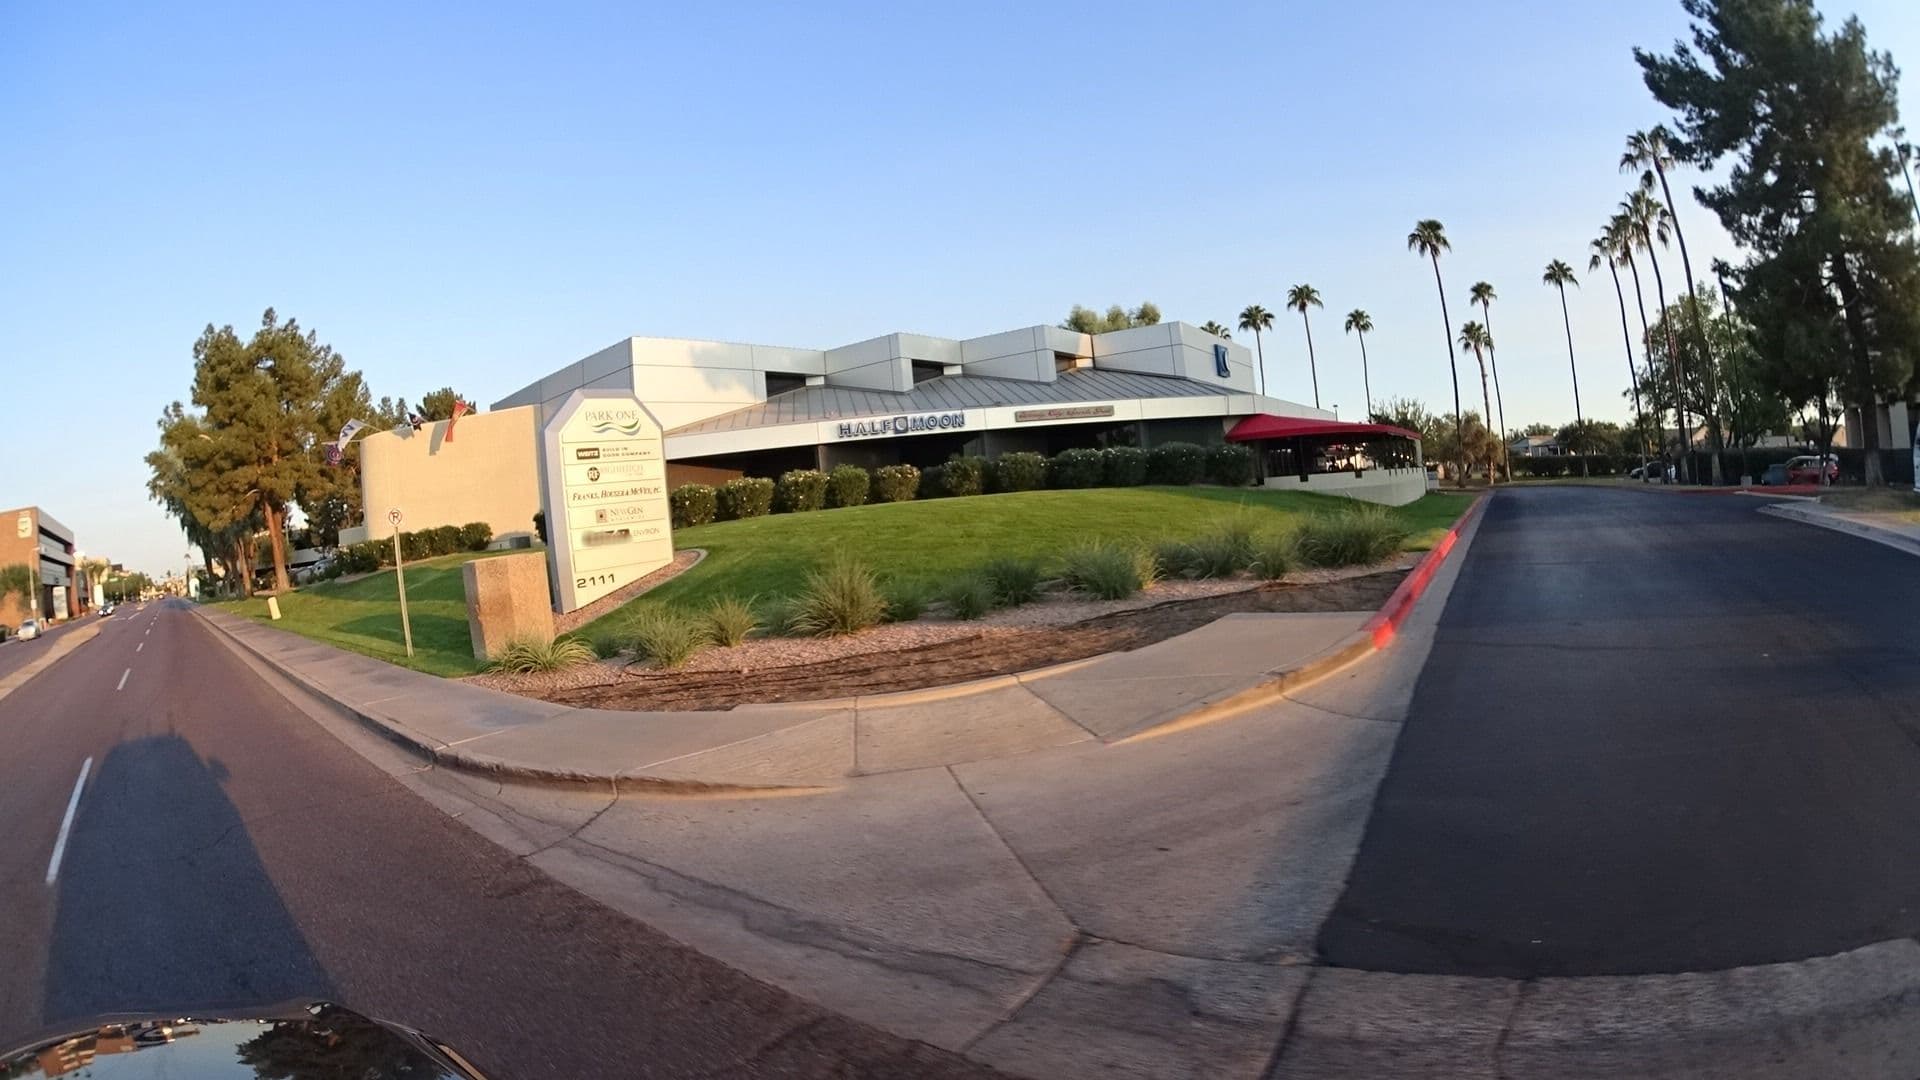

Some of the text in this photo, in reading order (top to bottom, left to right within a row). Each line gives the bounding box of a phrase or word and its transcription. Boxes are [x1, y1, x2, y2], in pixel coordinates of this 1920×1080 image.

[585, 409, 637, 421] PARK ONE
[839, 413, 965, 438] HALF MOON
[576, 573, 615, 589] 2111
